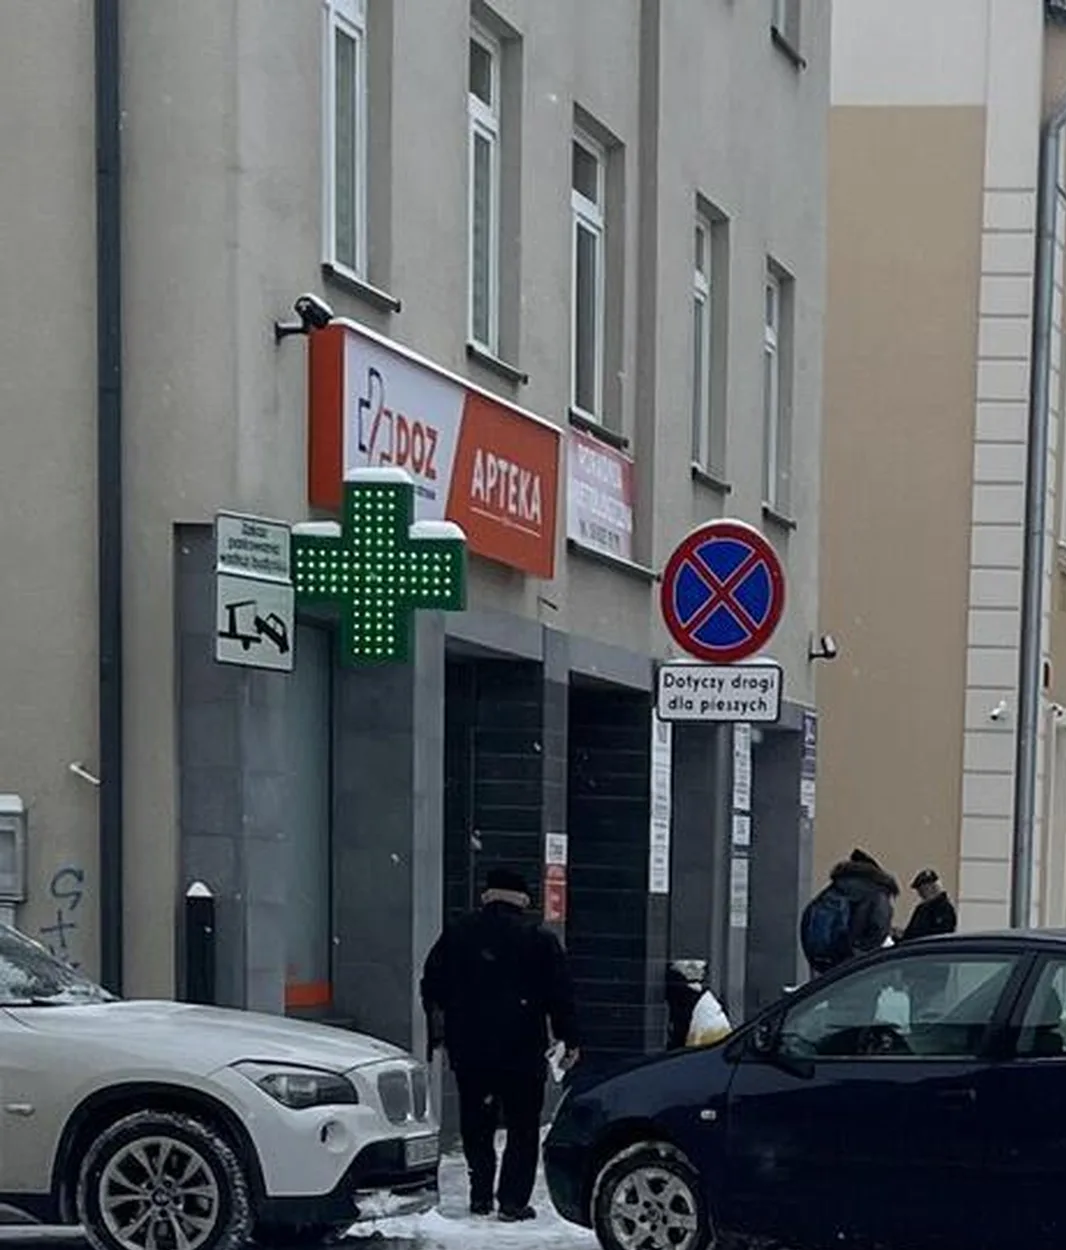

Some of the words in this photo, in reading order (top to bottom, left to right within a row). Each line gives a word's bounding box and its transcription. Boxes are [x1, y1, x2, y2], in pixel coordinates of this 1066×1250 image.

[396, 414, 438, 480] DOZ
[471, 448, 541, 526] APTEKA
[663, 672, 724, 693] Dotyczy
[731, 673, 774, 694] drogi
[668, 696, 693, 710] dla
[700, 697, 767, 716] pieszych
